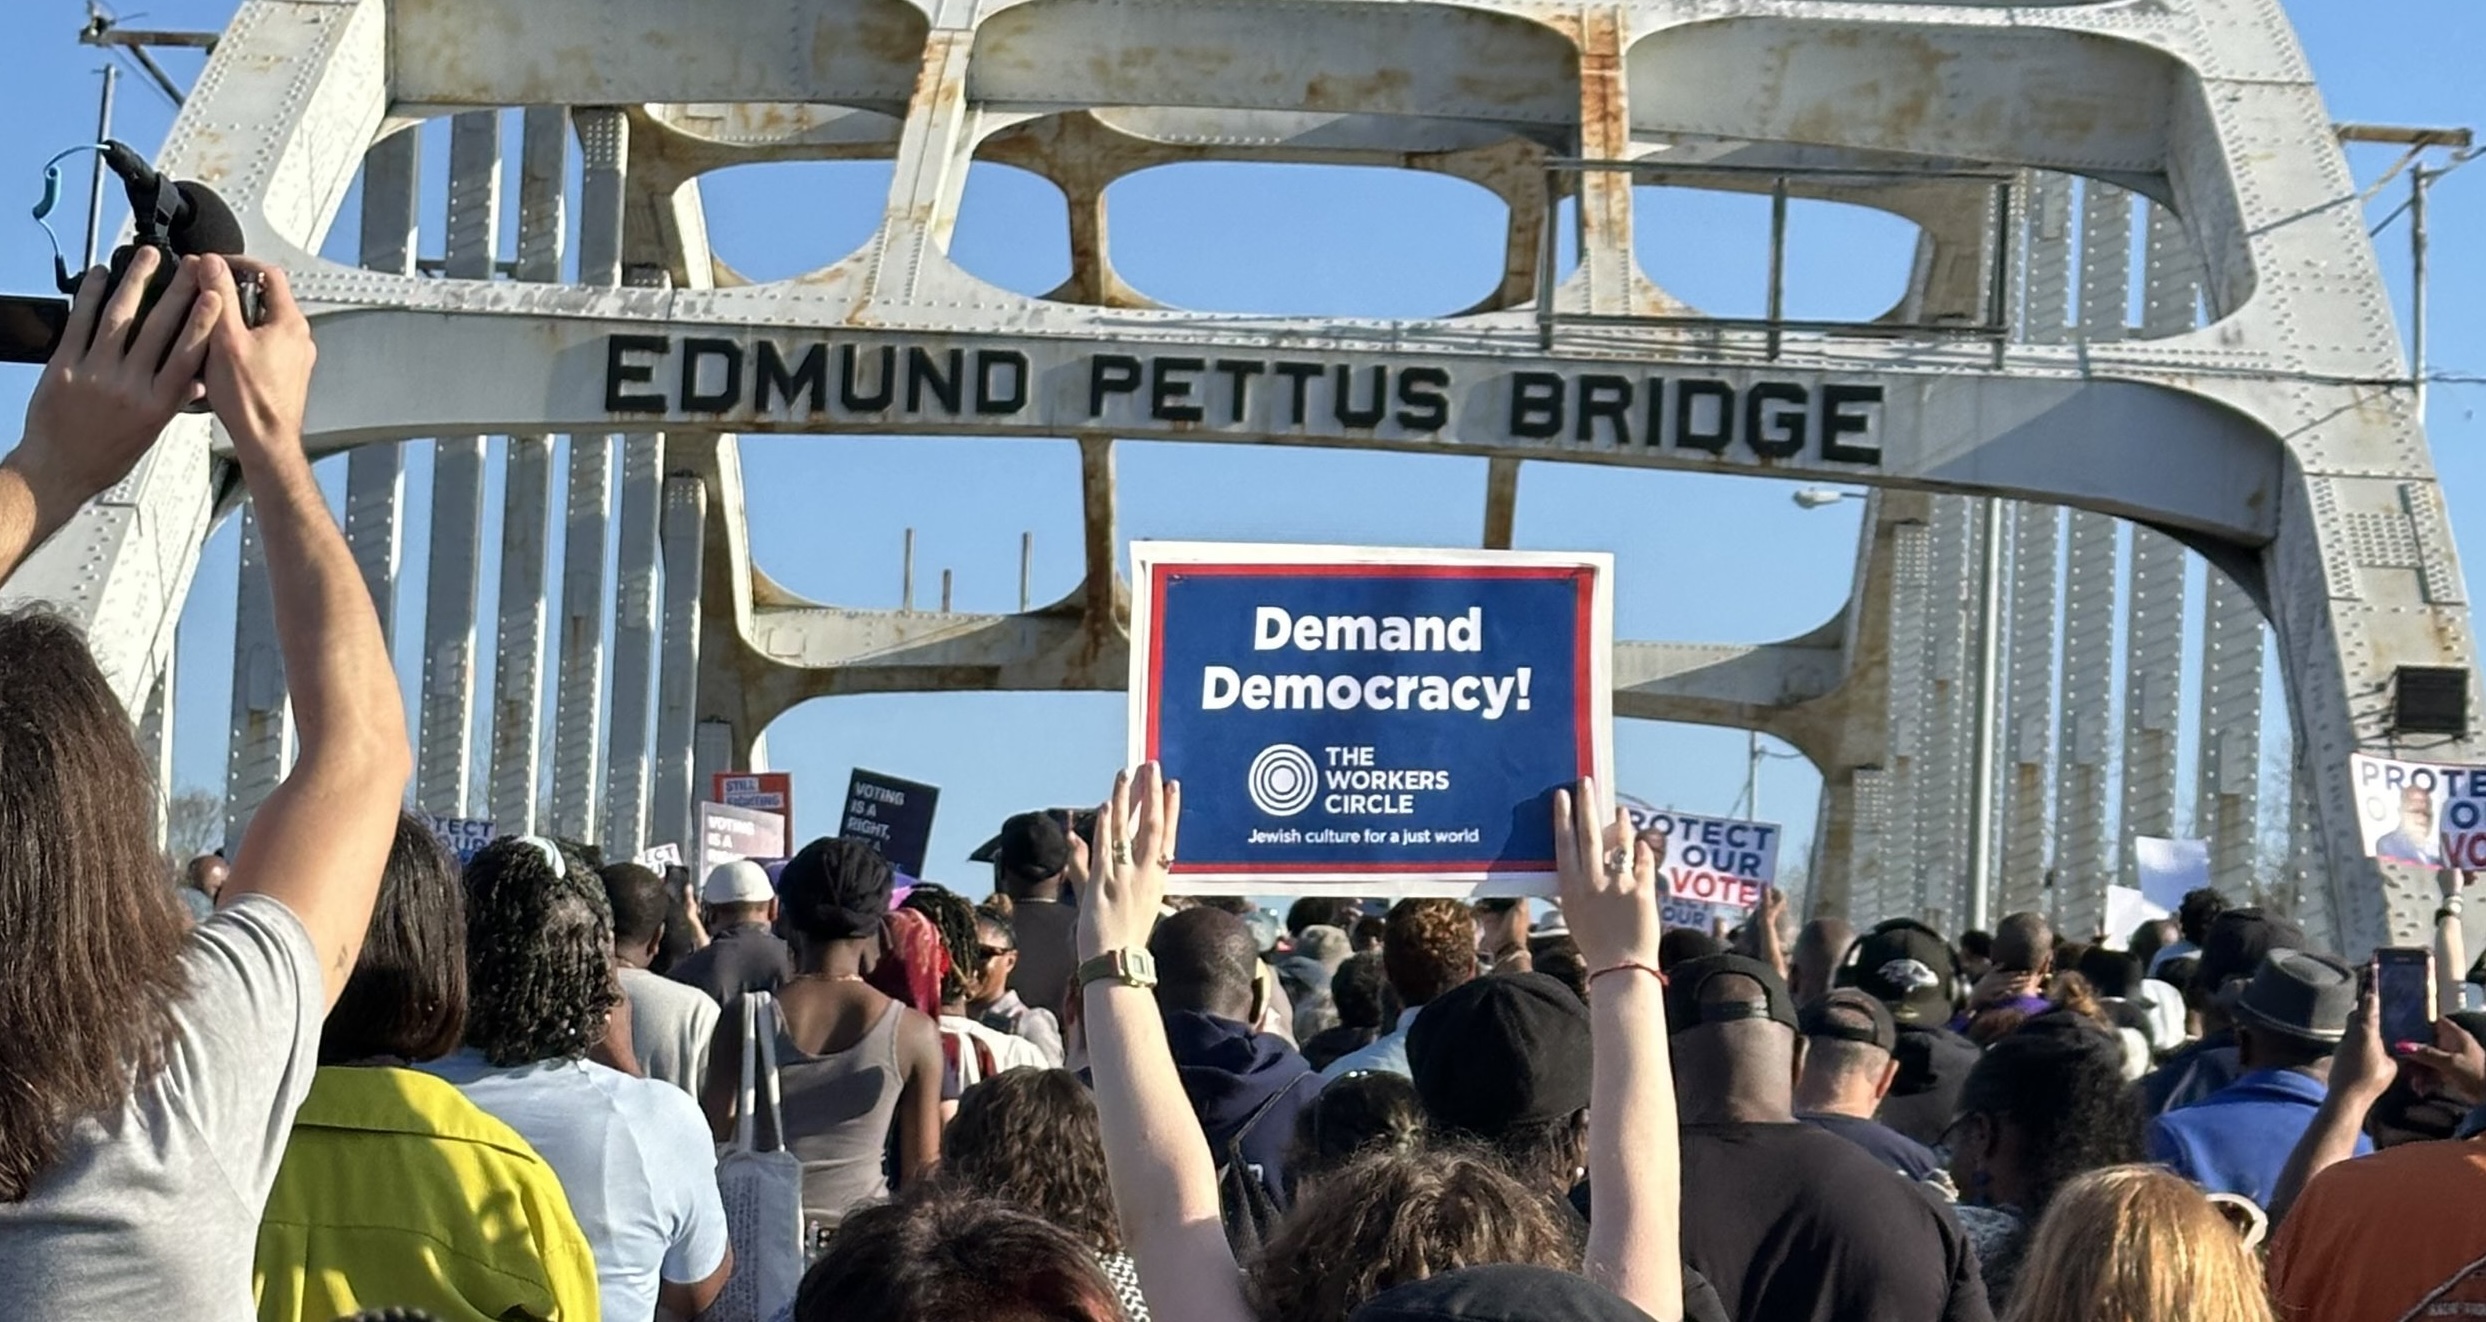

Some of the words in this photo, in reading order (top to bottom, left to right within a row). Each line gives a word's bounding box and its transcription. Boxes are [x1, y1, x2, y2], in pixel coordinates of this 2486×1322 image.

[604, 333, 1029, 414] EDMUND
[1089, 352, 1450, 433] PETTUS
[1508, 371, 1884, 465] BRIDGE
[1254, 606, 1482, 652] Demand
[1202, 665, 1532, 720] Democracy!
[1325, 746, 1375, 767] THE
[1325, 770, 1450, 791] WORKERS
[854, 781, 905, 806] VOTING
[1325, 794, 1414, 814] CIRCLE
[850, 799, 865, 815] IS
[866, 803, 877, 818] A
[432, 816, 495, 838] TECT
[847, 816, 891, 841] RIGHT,
[1248, 828, 1301, 844] Jewish
[1304, 828, 1360, 844] culture
[1363, 828, 1387, 844] for
[1389, 831, 1400, 844] a
[1402, 828, 1431, 846] just
[1435, 828, 1480, 844] world
[1629, 809, 1774, 850] ROTECT
[1682, 845, 1762, 878] OUR
[1662, 906, 1706, 928] OUR
